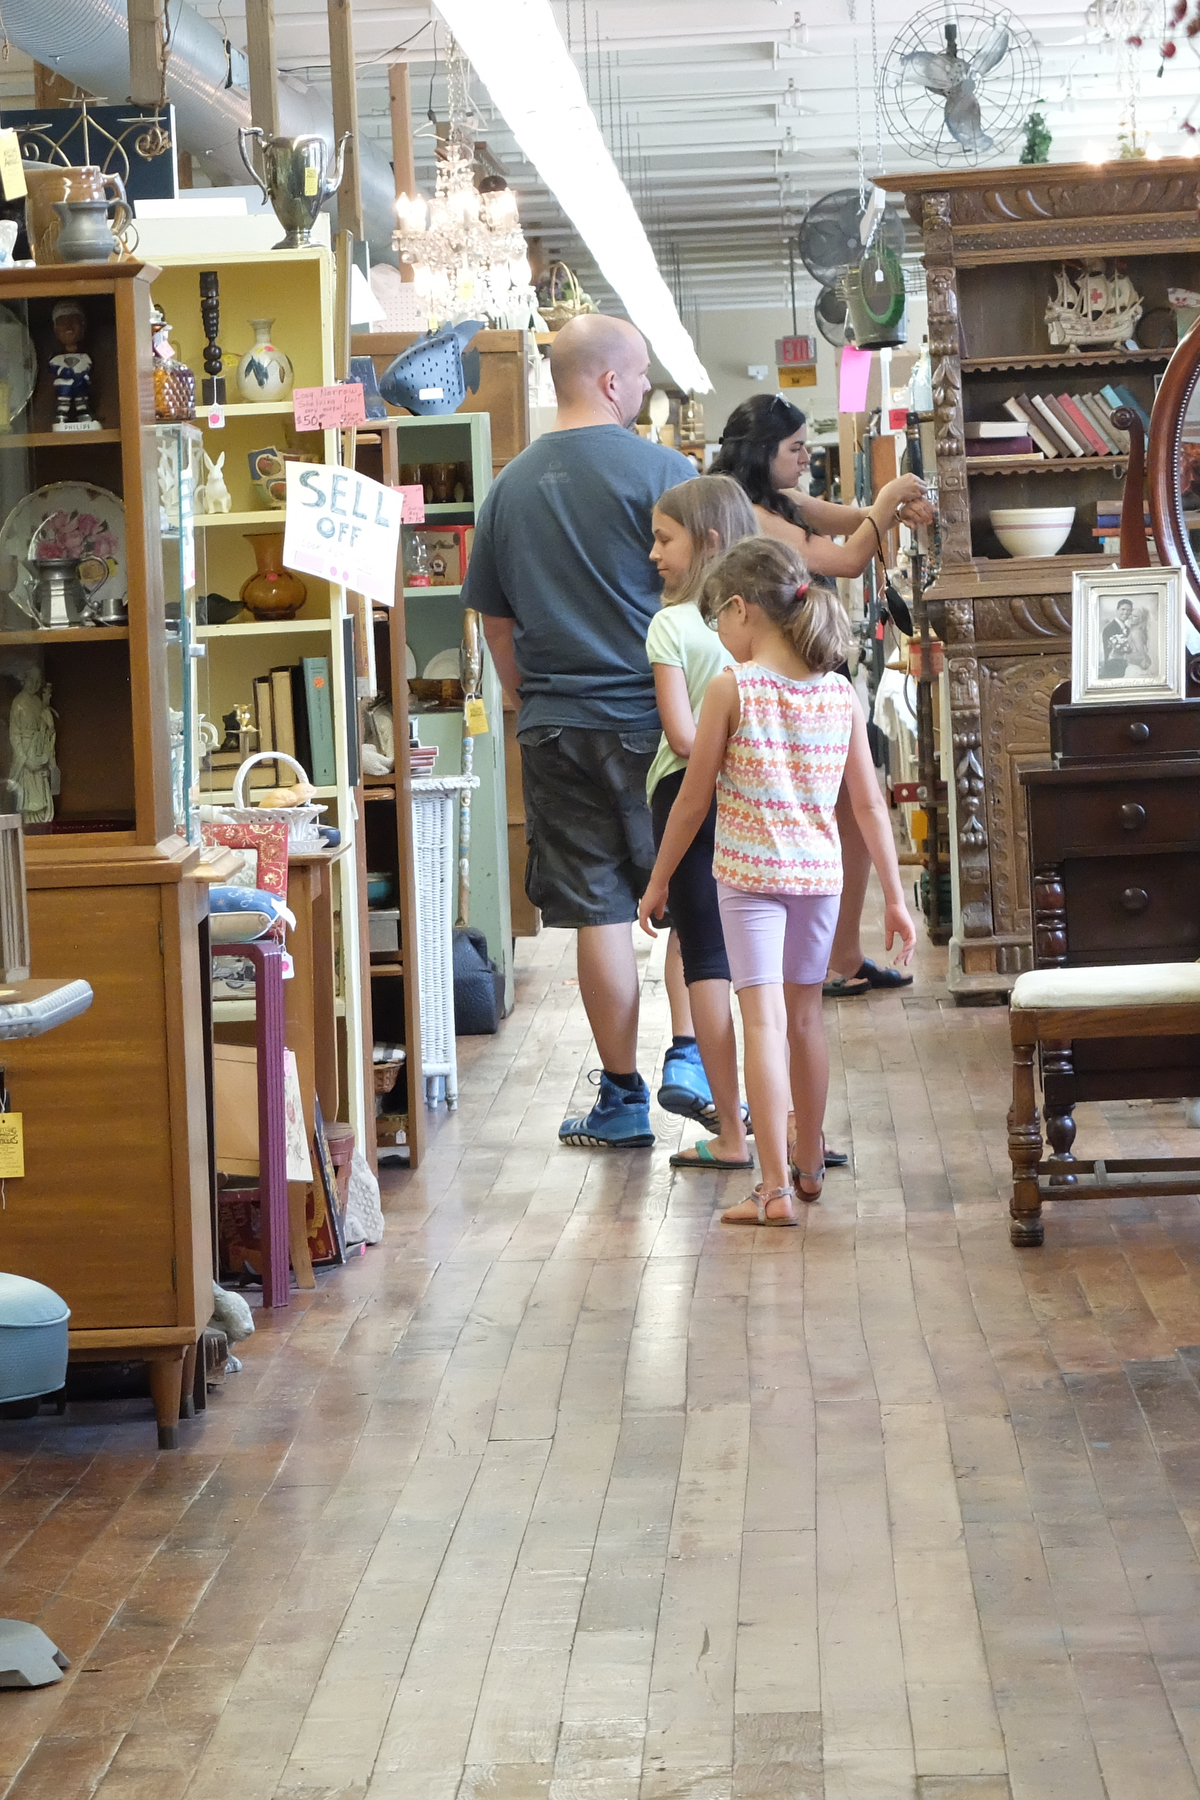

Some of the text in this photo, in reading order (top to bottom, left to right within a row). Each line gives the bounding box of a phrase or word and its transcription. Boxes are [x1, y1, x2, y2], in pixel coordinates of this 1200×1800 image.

[782, 338, 810, 363] EXIT
[320, 387, 357, 397] Narrow
[299, 469, 390, 528] SELL
[316, 516, 362, 547] OFF
